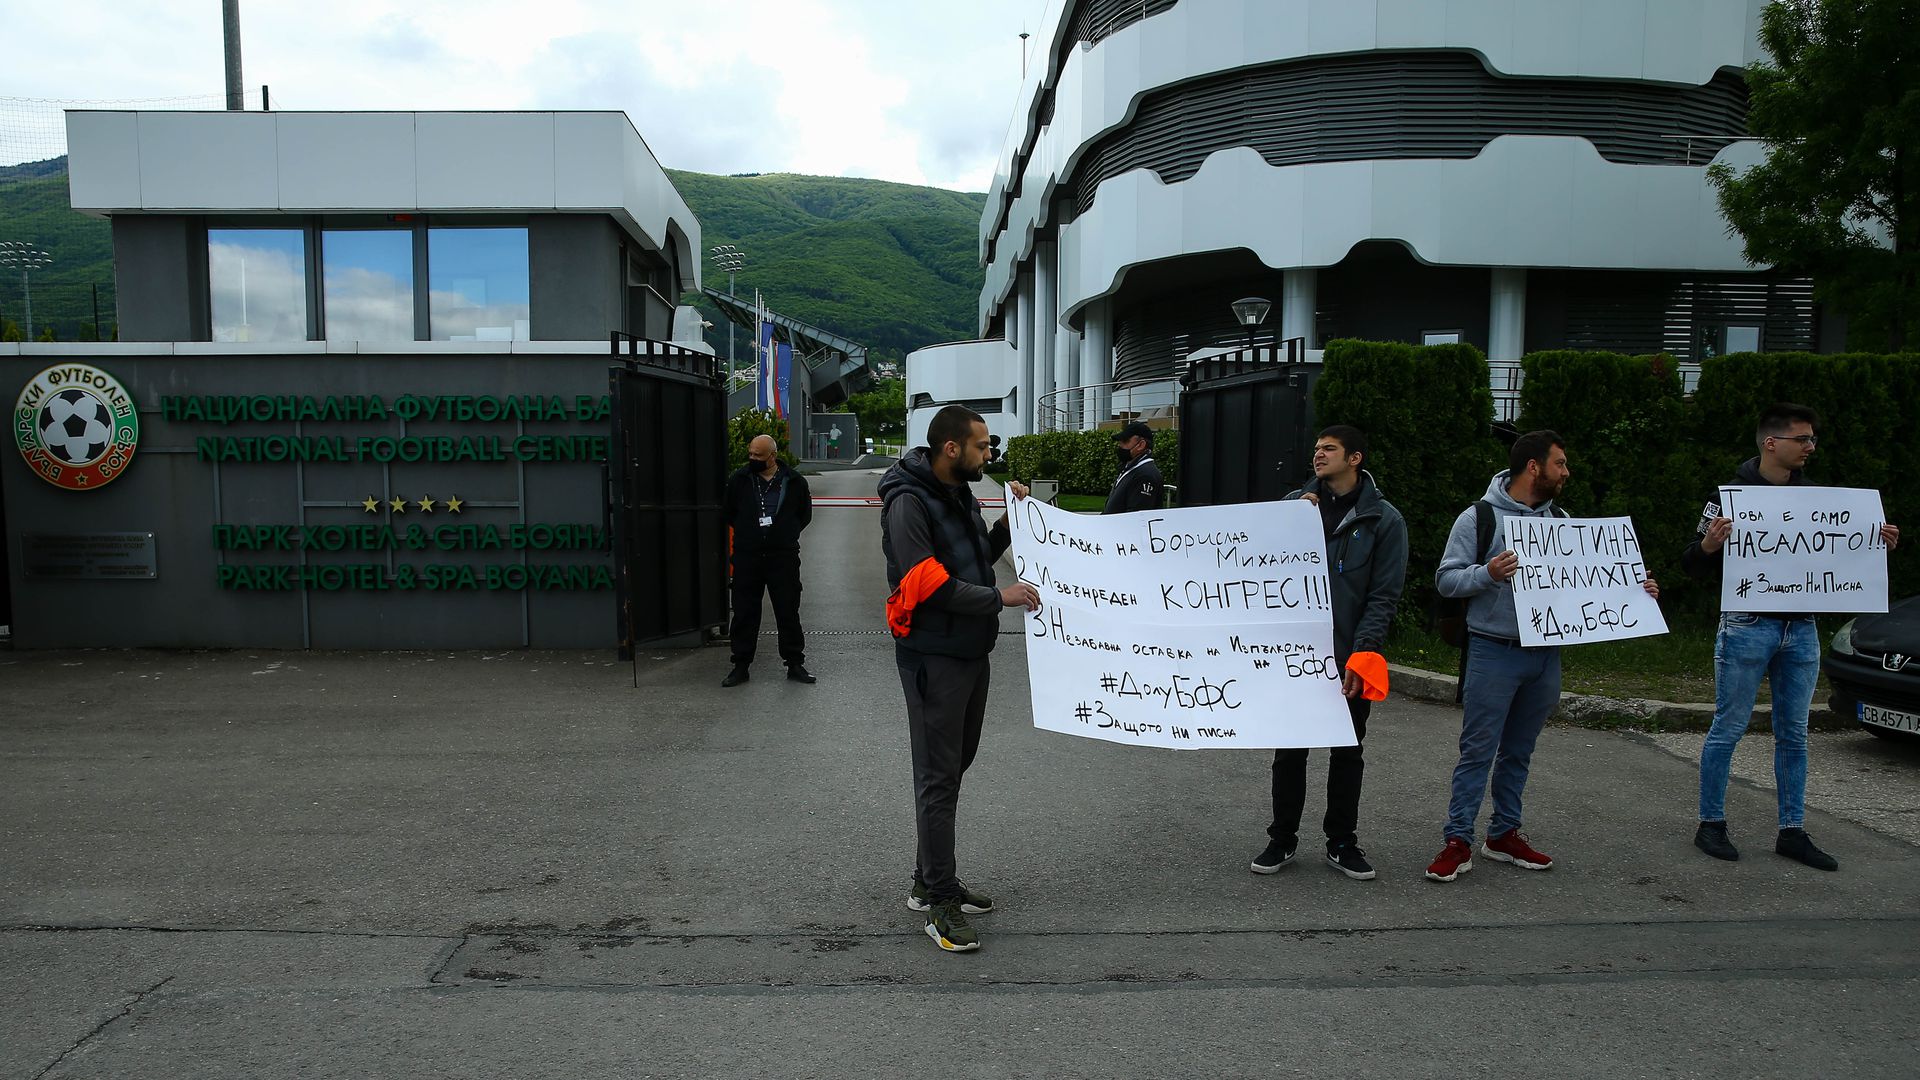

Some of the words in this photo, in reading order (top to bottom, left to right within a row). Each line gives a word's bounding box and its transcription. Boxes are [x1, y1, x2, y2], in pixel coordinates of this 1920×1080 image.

[20, 383, 62, 480] БЪЛГАРСКИ
[48, 367, 131, 418] ФУТБОЛЕН
[99, 426, 133, 478] СЪЮЗ
[161, 394, 388, 424] НАЦИОНАЛНА
[394, 394, 568, 421] ФУТБОЛНА
[196, 435, 349, 462] NATIONAL
[356, 435, 506, 462] FOOTBALL
[512, 435, 612, 461] CENTE
[212, 524, 293, 550] ПАРК
[301, 524, 399, 550] ХОТЕЛ
[405, 524, 426, 550] &
[433, 524, 501, 550] СПА
[1148, 519, 1250, 558] Борислав
[1511, 520, 1640, 558] НАИСТИНА
[1216, 546, 1321, 569] Михайлов
[217, 564, 292, 591] PARK
[300, 564, 390, 591] HOTEL
[396, 563, 417, 591] &
[424, 564, 479, 590] SPA
[485, 564, 614, 590] BOYANA
[1512, 562, 1646, 593] ПРЕКАЛИХТЕ
[1160, 575, 1330, 611] КОНГРЕС!!!
[1531, 601, 1639, 642] #ДолуБФС
[1285, 653, 1339, 681] БФС
[1099, 671, 1242, 713] #ДолуБФС
